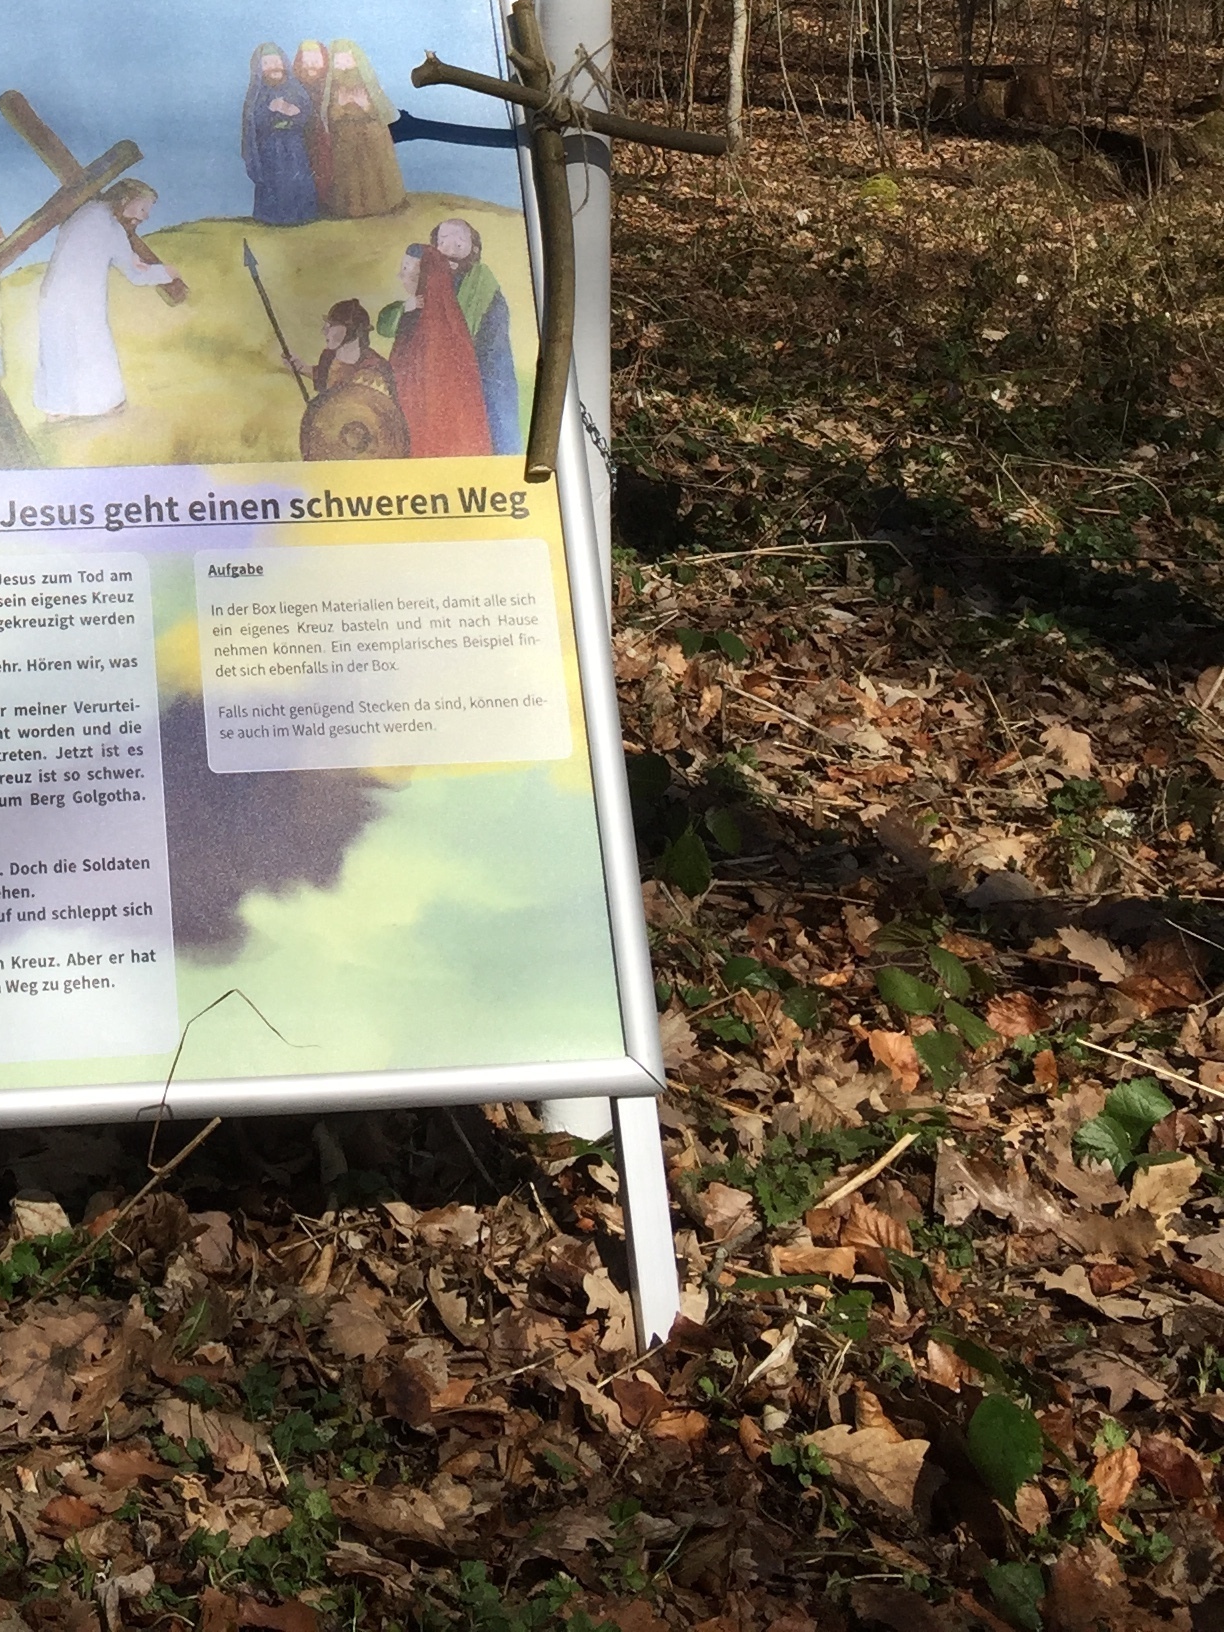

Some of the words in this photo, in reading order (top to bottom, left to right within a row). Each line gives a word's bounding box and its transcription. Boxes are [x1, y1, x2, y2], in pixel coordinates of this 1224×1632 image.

[0, 500, 94, 528] Jesus
[104, 495, 180, 531] geht
[188, 493, 280, 522] einen
[290, 490, 449, 519] schweren
[457, 485, 529, 520] Weg
[41, 573, 72, 584] zum
[77, 569, 104, 582] Tod
[109, 571, 132, 581] am
[207, 562, 263, 578] Aufgabe
[30, 592, 87, 609] eigenes
[91, 591, 134, 603] Kreuz
[226, 602, 249, 615] der
[251, 602, 276, 615] Box
[279, 601, 318, 617] liegen
[442, 595, 480, 608] damit
[483, 594, 506, 607] alle
[509, 593, 535, 605] sich
[79, 612, 134, 625] werden
[212, 623, 232, 636] ein
[239, 623, 289, 638] eigenes
[296, 621, 334, 633] Kreuz
[341, 618, 388, 632] basteln
[396, 616, 421, 630] und
[429, 616, 451, 628] mit
[458, 614, 490, 627] nach
[497, 614, 538, 625] Hause
[214, 643, 267, 656] nehmen
[462, 633, 513, 649] Beispiel
[26, 657, 71, 671] Hören
[76, 655, 104, 671] wir,
[108, 657, 137, 668] was
[215, 664, 237, 677] det
[268, 660, 328, 675] ebenfalls
[346, 659, 368, 672] der
[14, 701, 67, 716] meiner
[73, 698, 139, 713] Verurtei-
[218, 704, 248, 718] Falls
[251, 703, 286, 717] nicht
[289, 700, 354, 719] genügend
[358, 699, 410, 713] Stecken
[17, 723, 74, 738] worden
[82, 721, 111, 735] und
[118, 720, 141, 734] die
[237, 724, 269, 738] auch
[291, 722, 325, 736] Wald
[328, 721, 380, 738] gesucht
[55, 745, 93, 759] Jetzt
[101, 743, 119, 757] ist
[127, 745, 143, 756] es
[38, 768, 57, 782] ist
[63, 770, 80, 781] so
[87, 766, 144, 780] schwer.
[30, 792, 65, 808] Berg
[72, 788, 145, 806] Golgotha.
[9, 860, 47, 875] Doch
[53, 858, 76, 873] die
[82, 857, 150, 871] Soldaten
[16, 906, 46, 921] und
[51, 904, 117, 921] schleppt
[122, 901, 152, 916] sich
[11, 955, 60, 969] Kreuz.
[66, 952, 102, 966] Aber
[108, 953, 124, 964] er
[130, 949, 156, 963] hat
[4, 979, 38, 995] Weg
[41, 980, 58, 991] zu
[63, 975, 115, 993] gehen.
